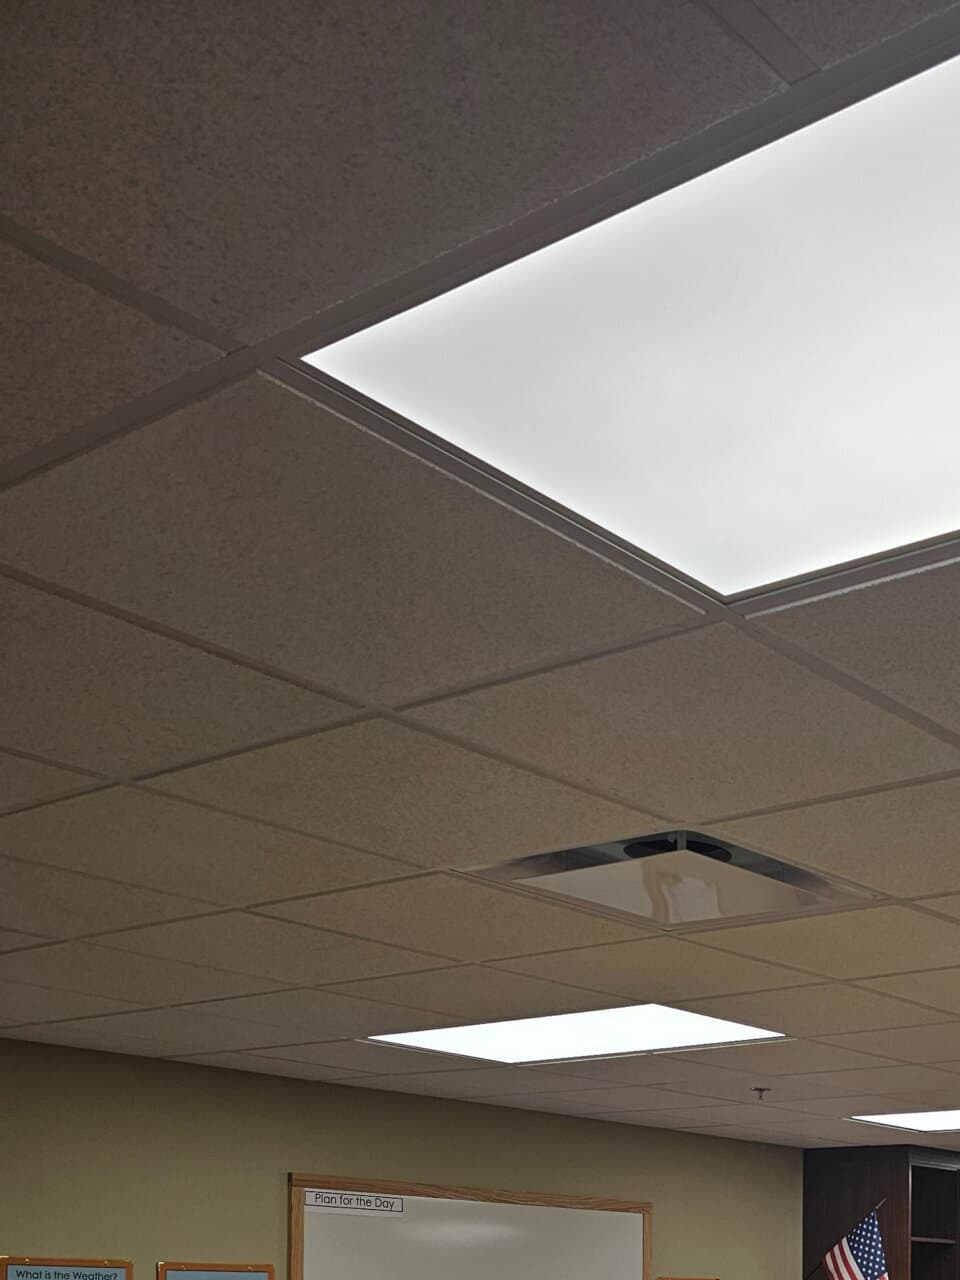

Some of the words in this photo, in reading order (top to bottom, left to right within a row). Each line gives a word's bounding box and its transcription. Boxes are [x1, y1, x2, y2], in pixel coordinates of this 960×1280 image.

[315, 1193, 337, 1204] Plan
[340, 1195, 353, 1206] for
[356, 1196, 372, 1207] the
[375, 1197, 395, 1211] Day
[16, 1269, 42, 1279] What
[45, 1270, 52, 1279] is
[54, 1271, 70, 1280] the
[73, 1271, 118, 1280] Weather?
